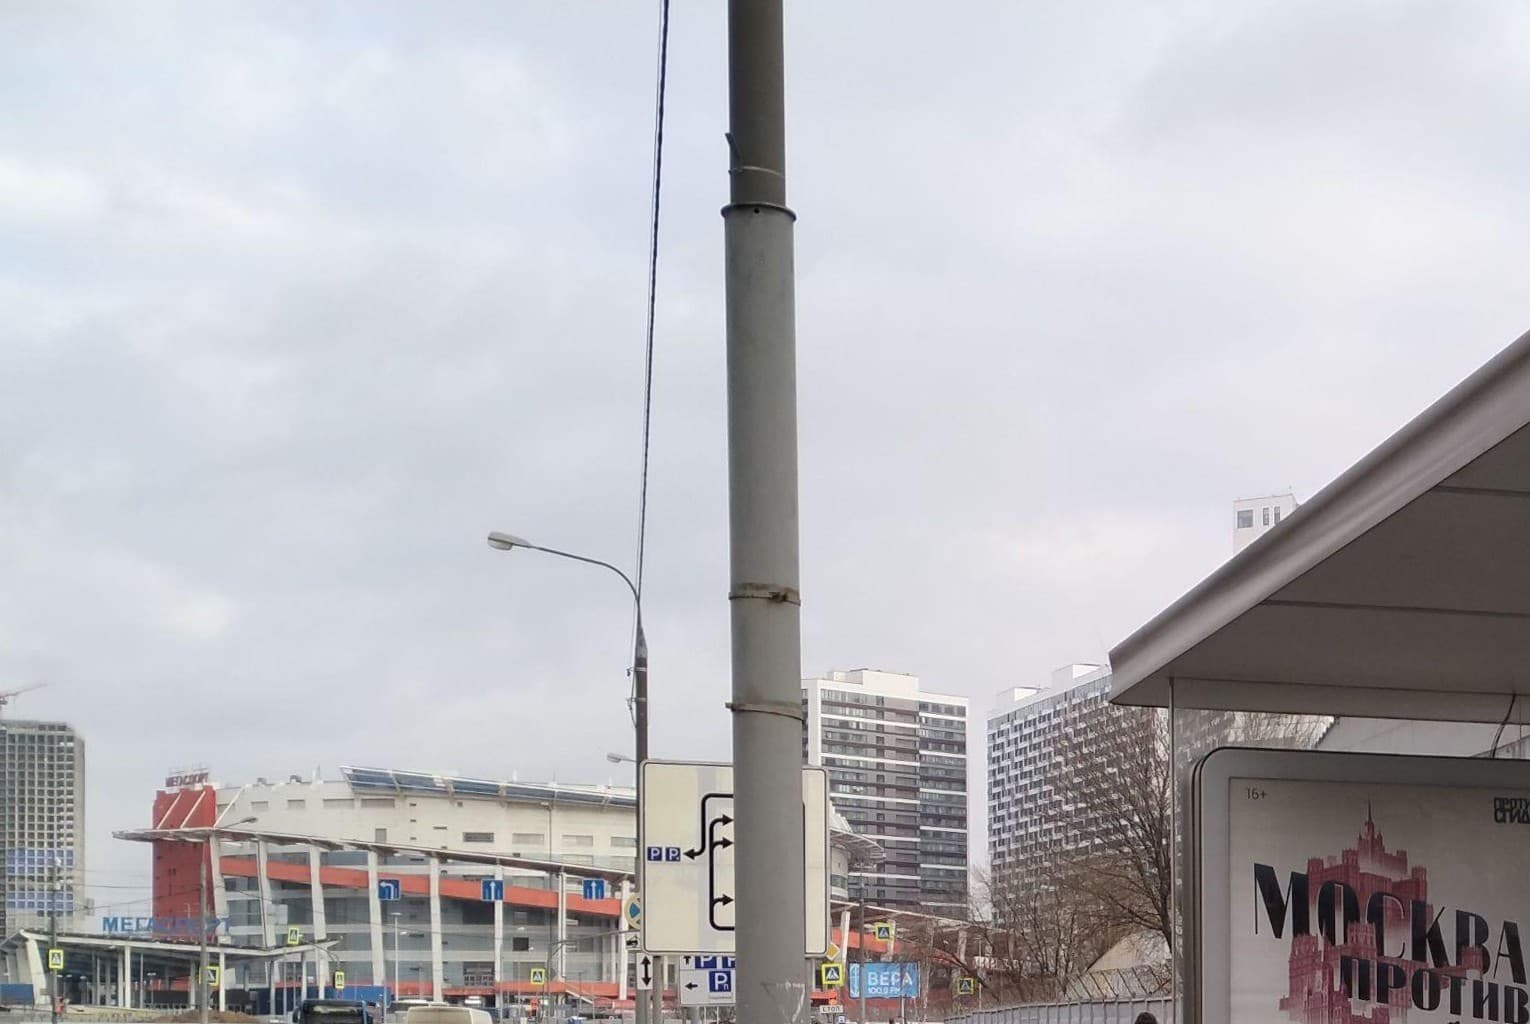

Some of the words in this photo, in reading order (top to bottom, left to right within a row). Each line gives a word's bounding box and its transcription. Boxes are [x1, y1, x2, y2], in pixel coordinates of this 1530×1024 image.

[1246, 786, 1268, 800] 16+
[1254, 863, 1528, 986] МОСКВА
[868, 971, 912, 986] ВЕРА
[1340, 956, 1530, 1024] ПРОТИВ
